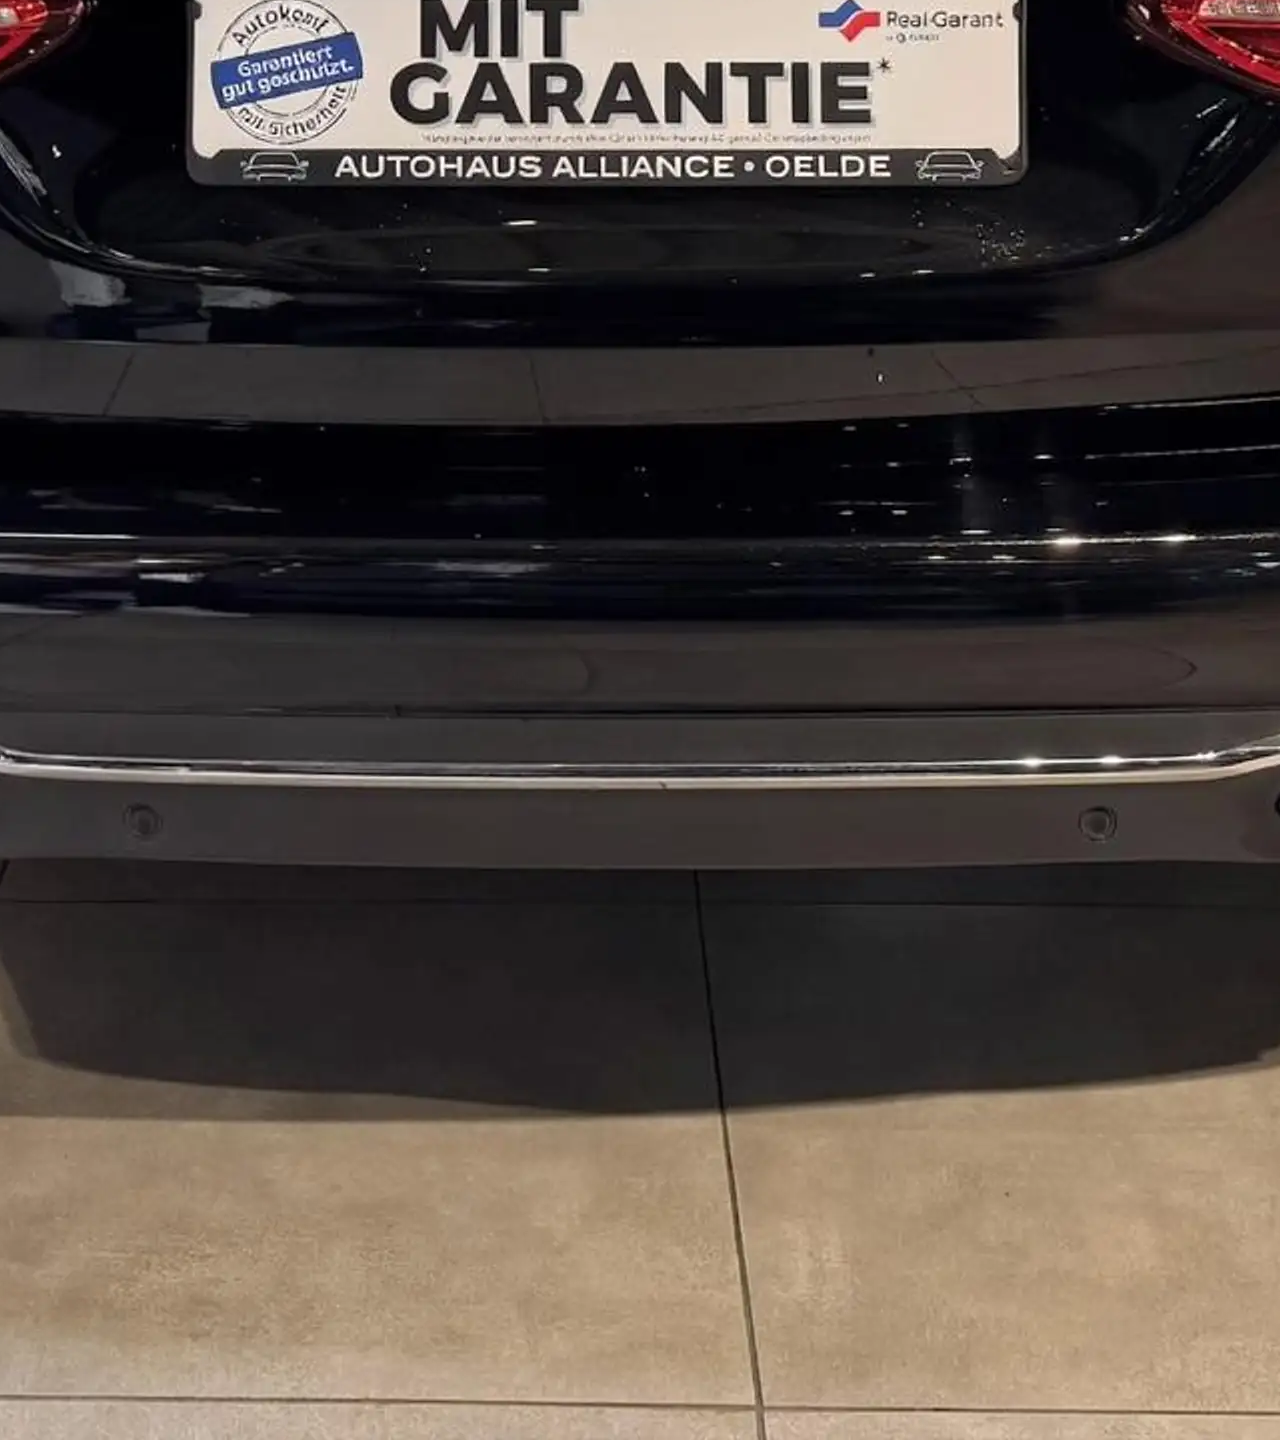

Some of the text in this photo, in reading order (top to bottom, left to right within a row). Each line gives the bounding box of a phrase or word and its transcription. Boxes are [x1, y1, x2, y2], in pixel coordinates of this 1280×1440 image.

[333, 154, 892, 179] AUTOHAUS ALLIANCE OELDE
